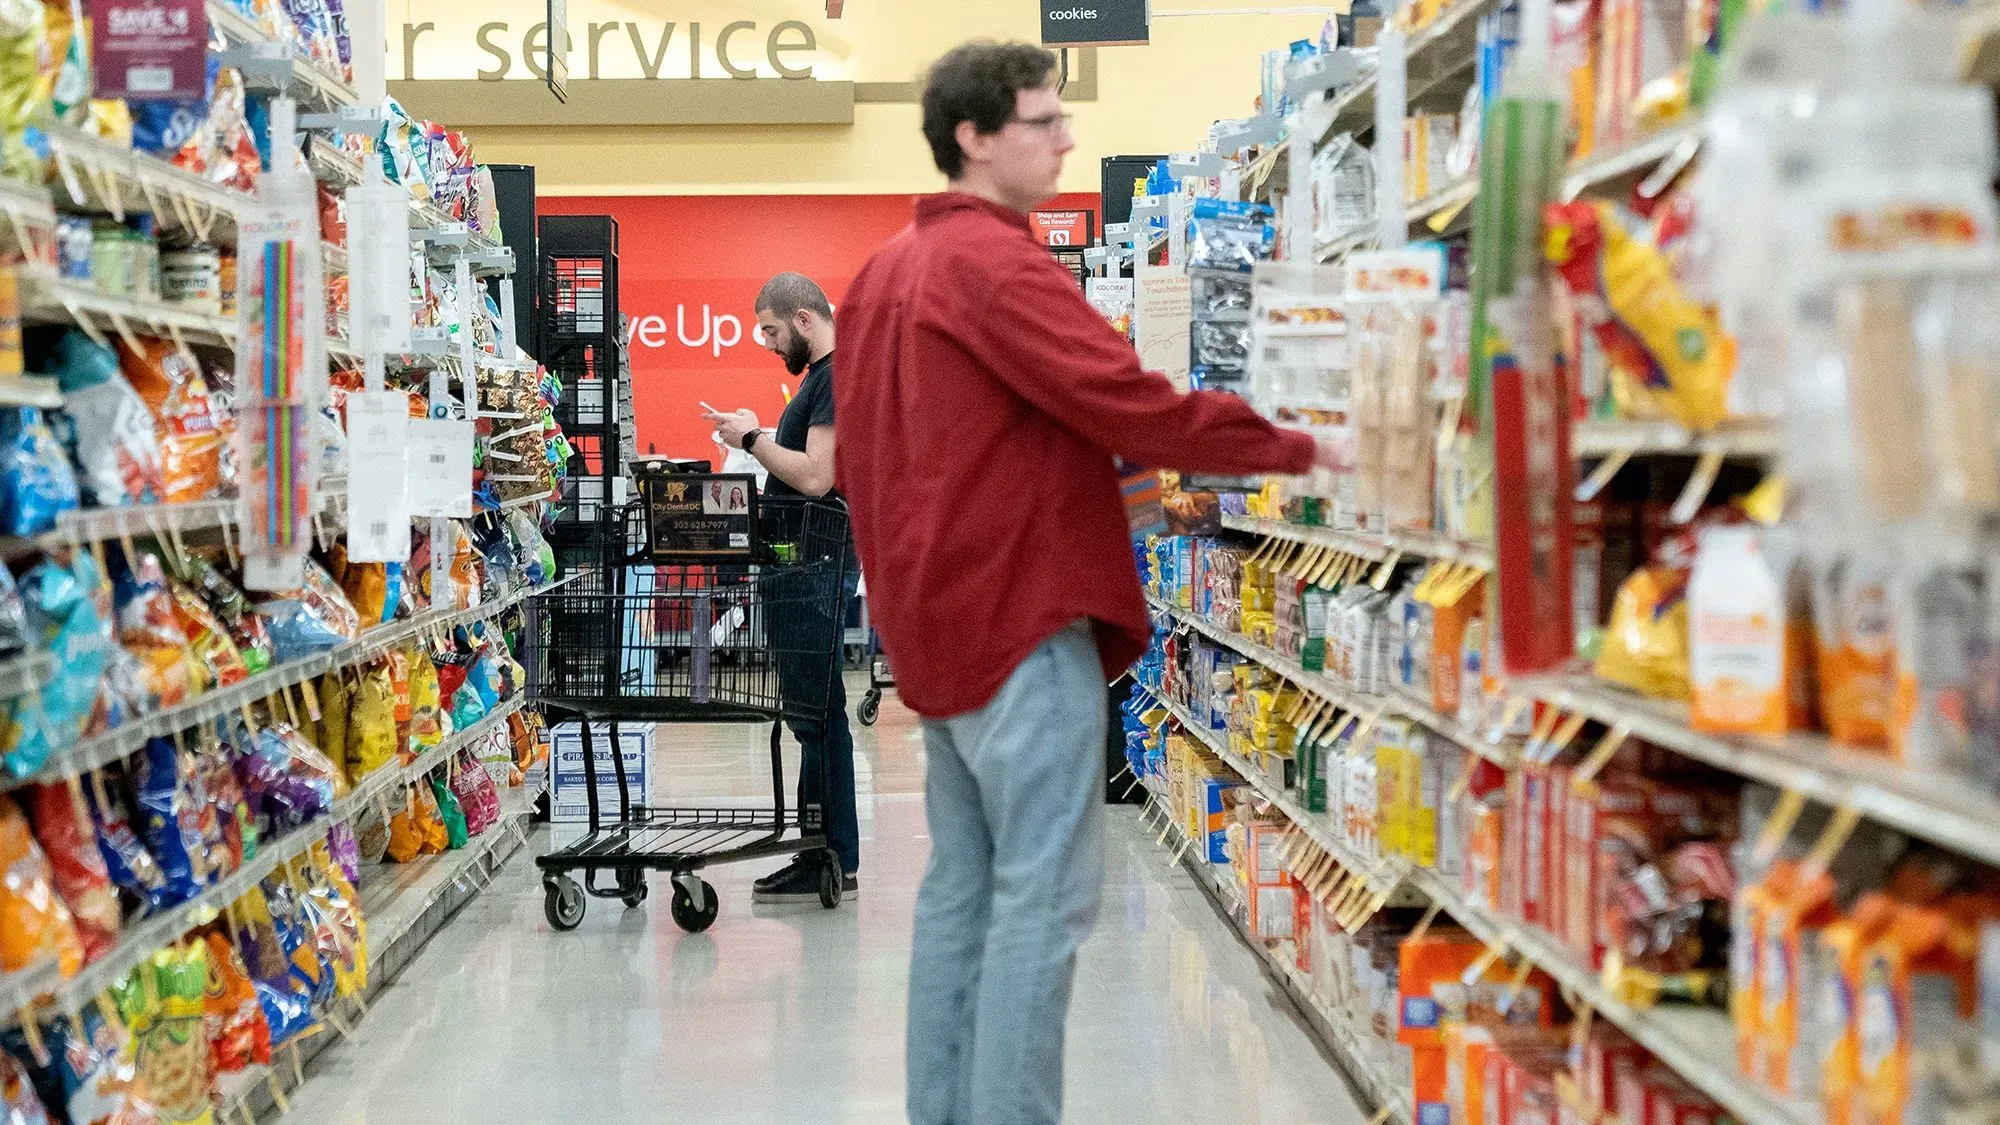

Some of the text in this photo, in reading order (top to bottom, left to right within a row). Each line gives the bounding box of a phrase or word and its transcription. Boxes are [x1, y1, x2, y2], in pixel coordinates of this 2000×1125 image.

[1049, 7, 1098, 20] cookies
[475, 19, 817, 80] service
[677, 304, 742, 358] Up
[652, 503, 666, 511] City
[689, 503, 701, 511] DC
